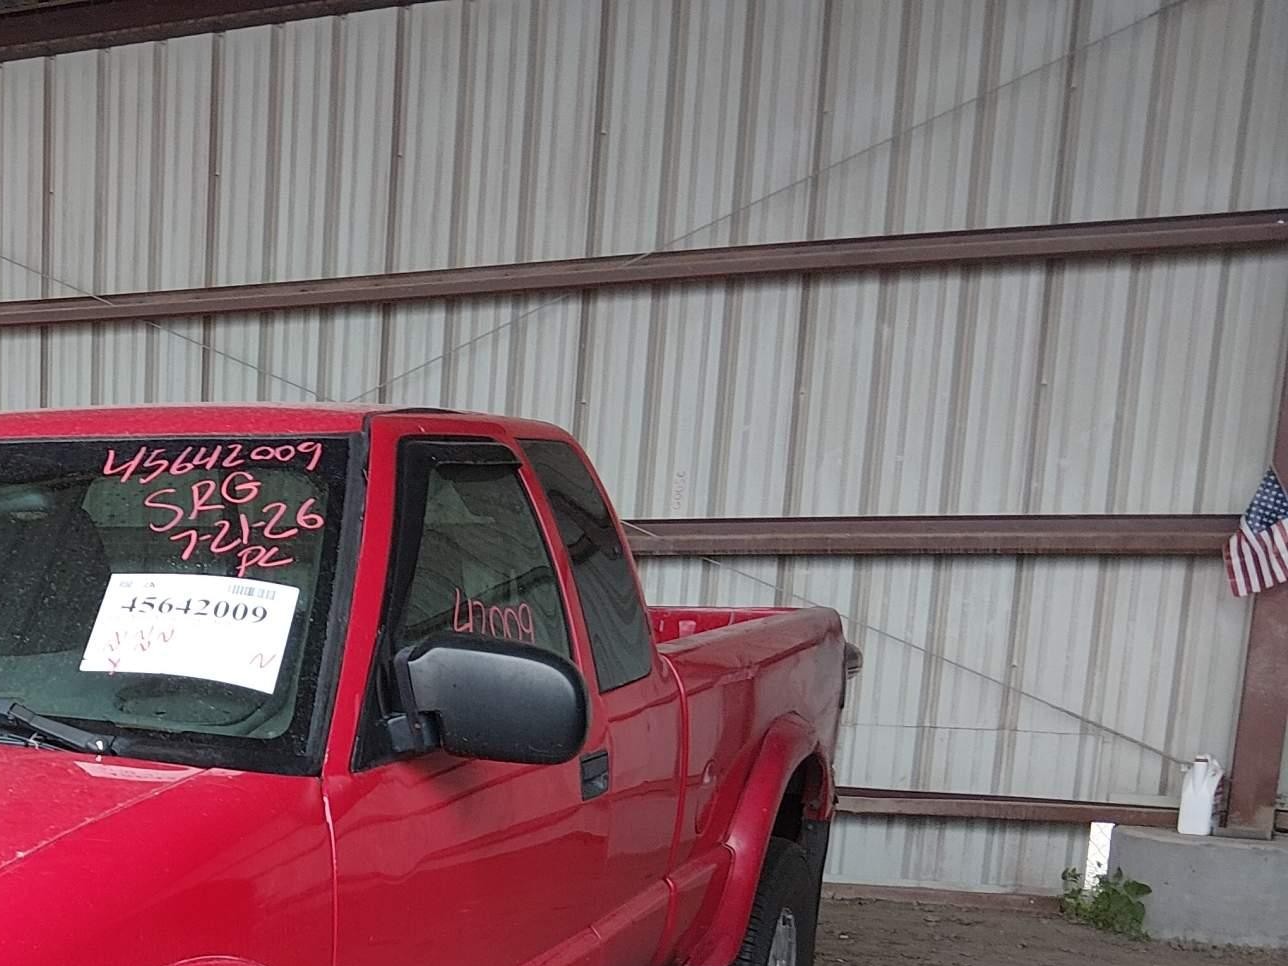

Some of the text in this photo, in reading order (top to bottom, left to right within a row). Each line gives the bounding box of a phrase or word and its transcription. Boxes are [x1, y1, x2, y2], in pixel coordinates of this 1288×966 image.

[103, 441, 322, 483] 45642009
[144, 471, 261, 532] SRG
[170, 499, 325, 560] 7-21-26
[120, 596, 268, 623] 45642009
